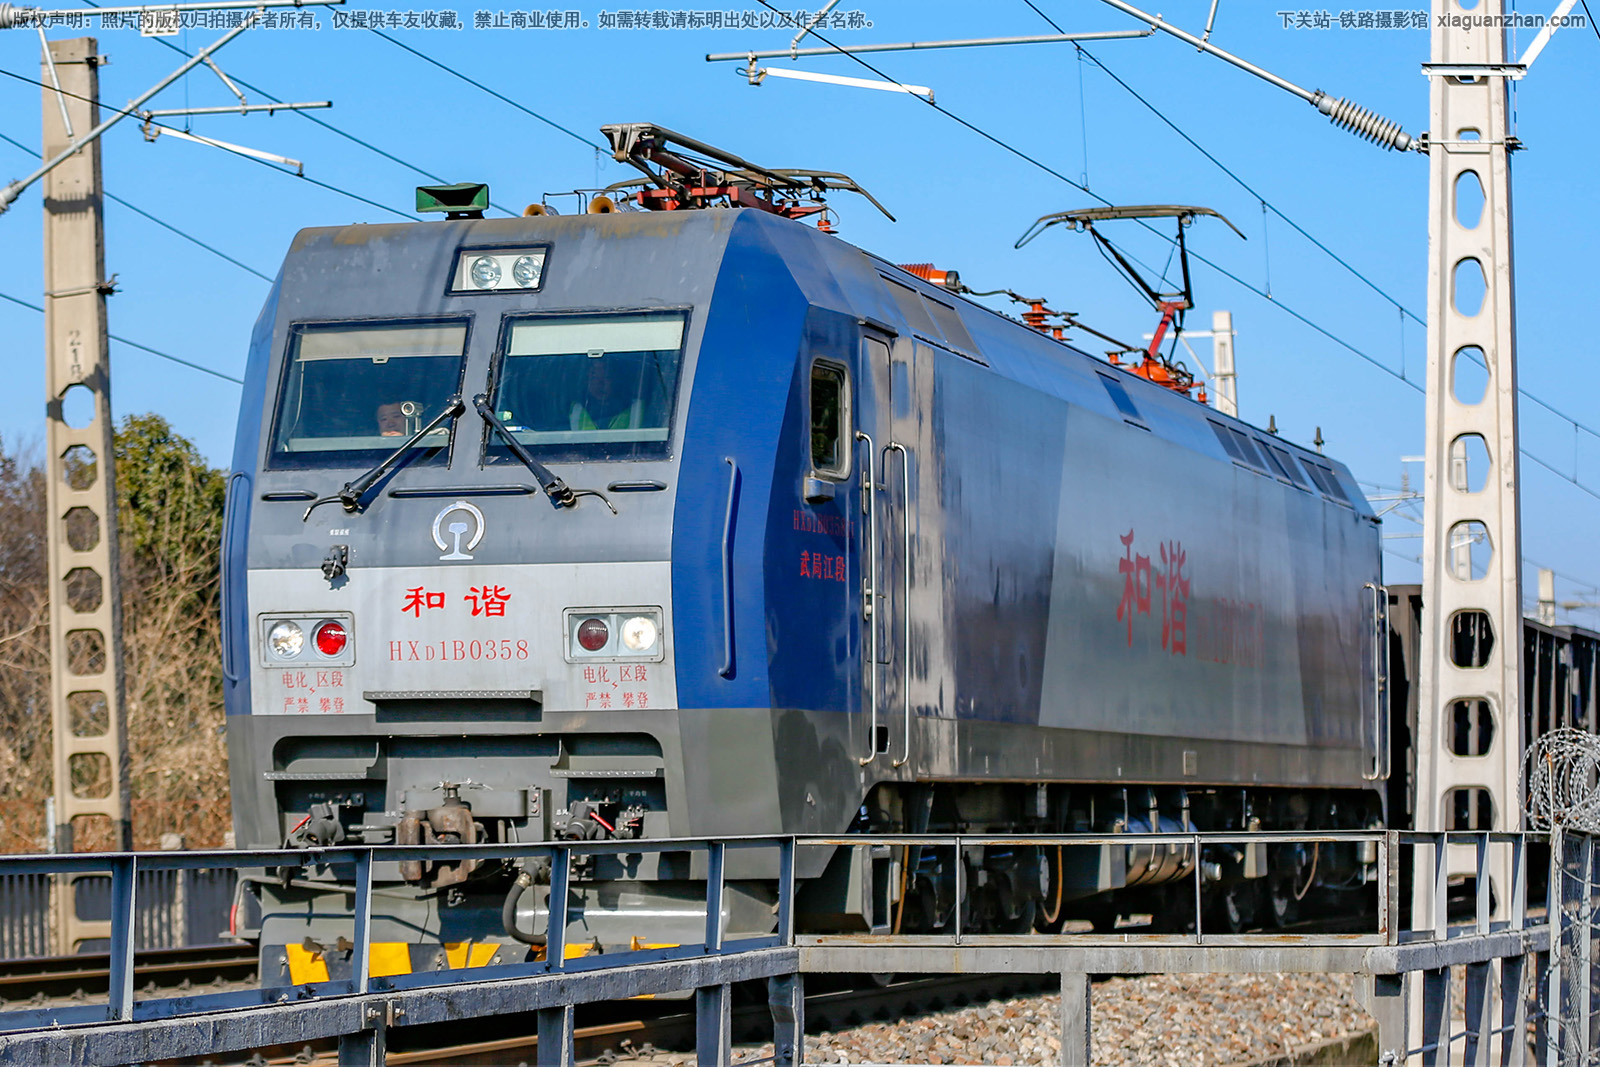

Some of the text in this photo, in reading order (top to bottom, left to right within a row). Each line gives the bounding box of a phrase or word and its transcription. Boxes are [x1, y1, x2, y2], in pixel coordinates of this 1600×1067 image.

[800, 550, 845, 582] 武局江段
[401, 585, 511, 618] 和谐
[1116, 528, 1190, 657] 和谐
[389, 639, 529, 661] HXD1B0358
[282, 670, 344, 688] 电化 区段
[584, 665, 647, 683] 电化 区段
[284, 697, 344, 713] 严禁 攀登
[585, 692, 648, 708] 严禁 攀登
